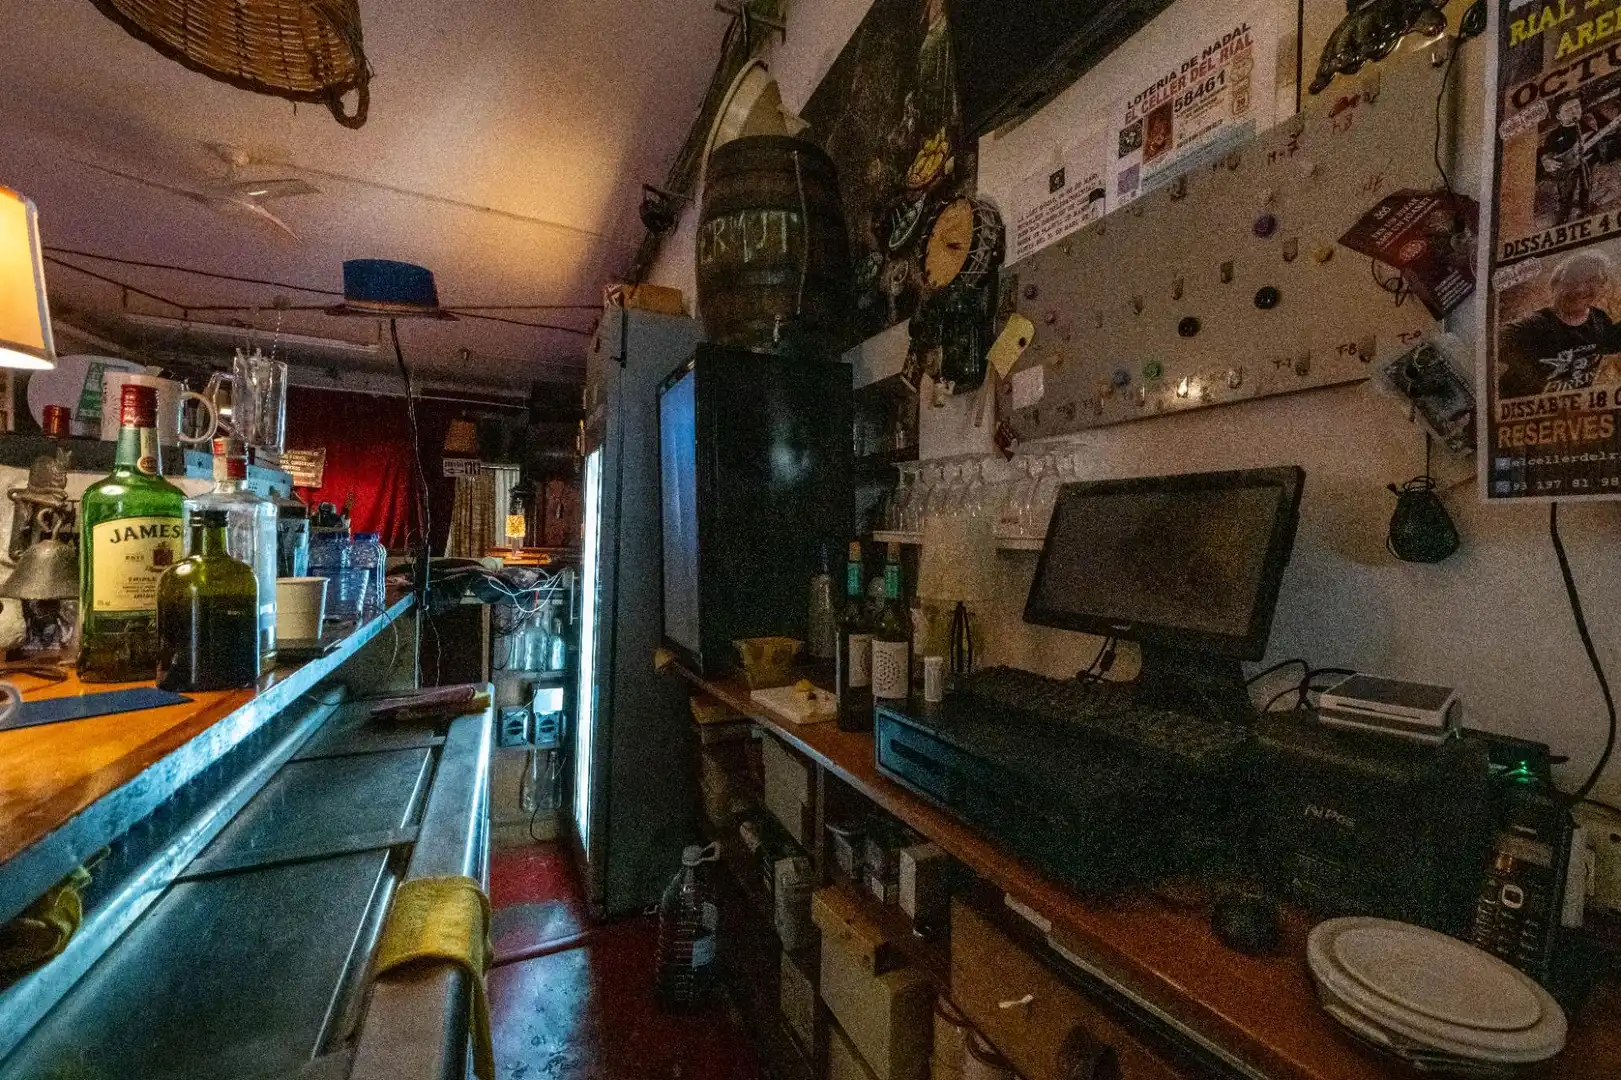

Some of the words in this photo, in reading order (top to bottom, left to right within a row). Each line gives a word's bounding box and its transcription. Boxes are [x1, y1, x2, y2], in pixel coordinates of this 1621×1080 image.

[1509, 0, 1576, 48] RIAL
[1554, 6, 1621, 60] ARE
[1125, 106, 1138, 125] EL
[1142, 77, 1186, 114] CELLER
[1190, 58, 1216, 83] DEL
[1219, 33, 1254, 61] RIAL
[1127, 71, 1177, 109] LOTERIA
[1181, 55, 1198, 73] DE
[1202, 23, 1251, 58] NADAL
[1174, 69, 1225, 113] 58461
[1504, 218, 1591, 258] DISSABTE
[1599, 214, 1611, 232] 4
[1501, 394, 1583, 420] DISSABTE
[1498, 413, 1615, 449] RESERVES
[1512, 451, 1621, 467] elcellerdelr
